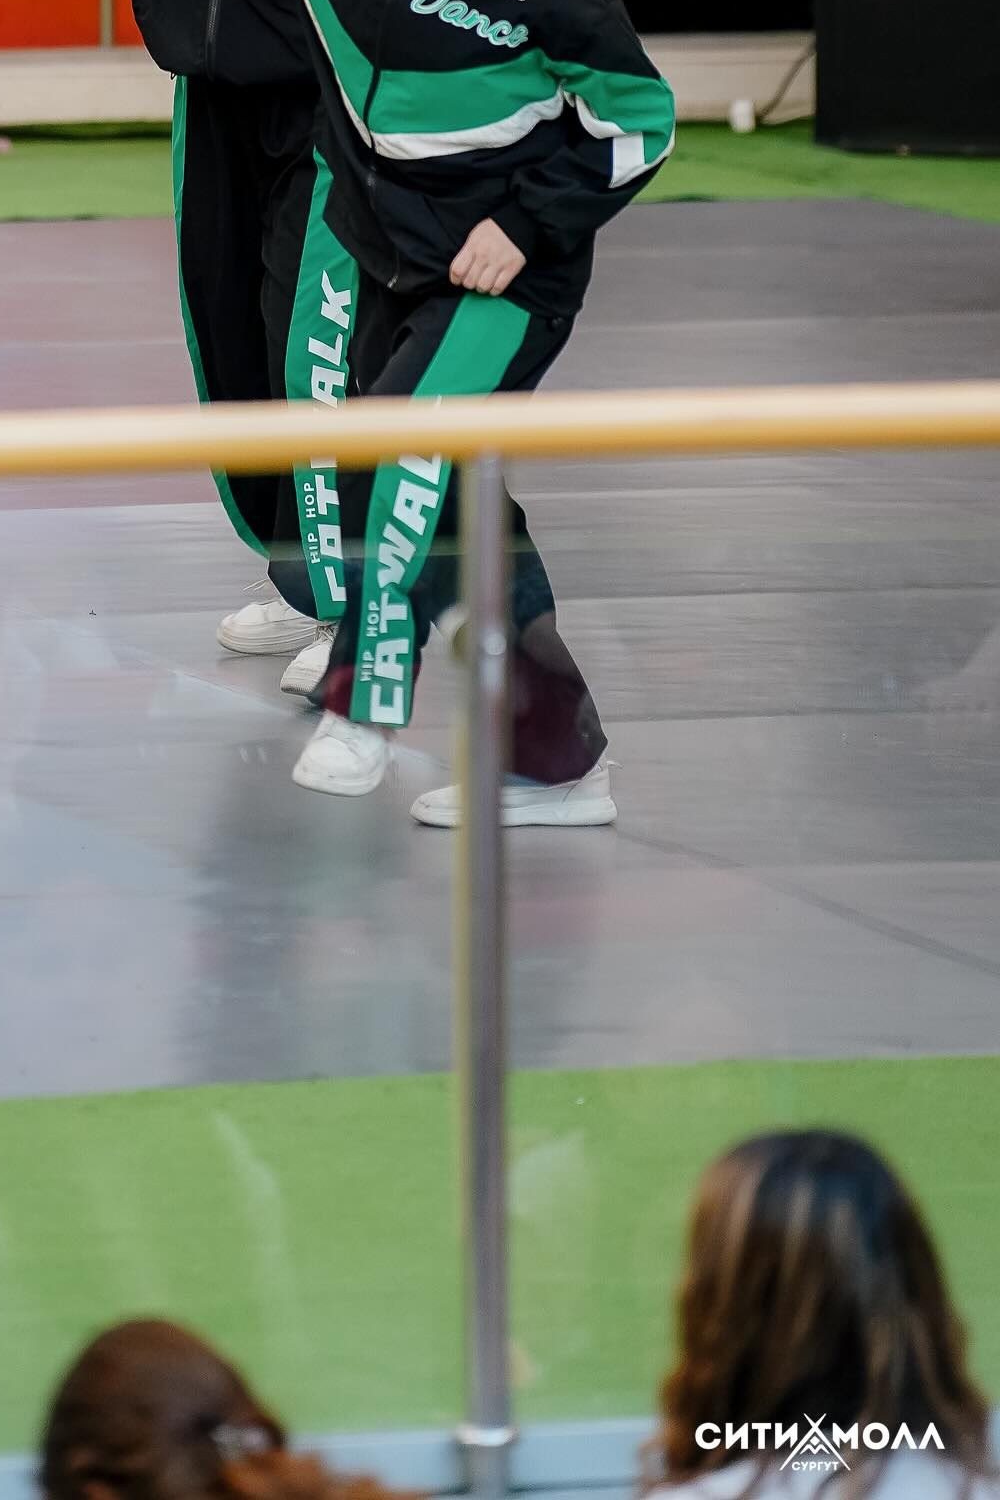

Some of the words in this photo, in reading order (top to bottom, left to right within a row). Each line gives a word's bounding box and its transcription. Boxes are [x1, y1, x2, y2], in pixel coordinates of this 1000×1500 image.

[308, 269, 352, 602] CATALK
[303, 482, 317, 519] HOP
[307, 532, 321, 565] HIP
[369, 393, 443, 726] CATWAL
[366, 600, 380, 637] HOP
[360, 649, 375, 682] HIP
